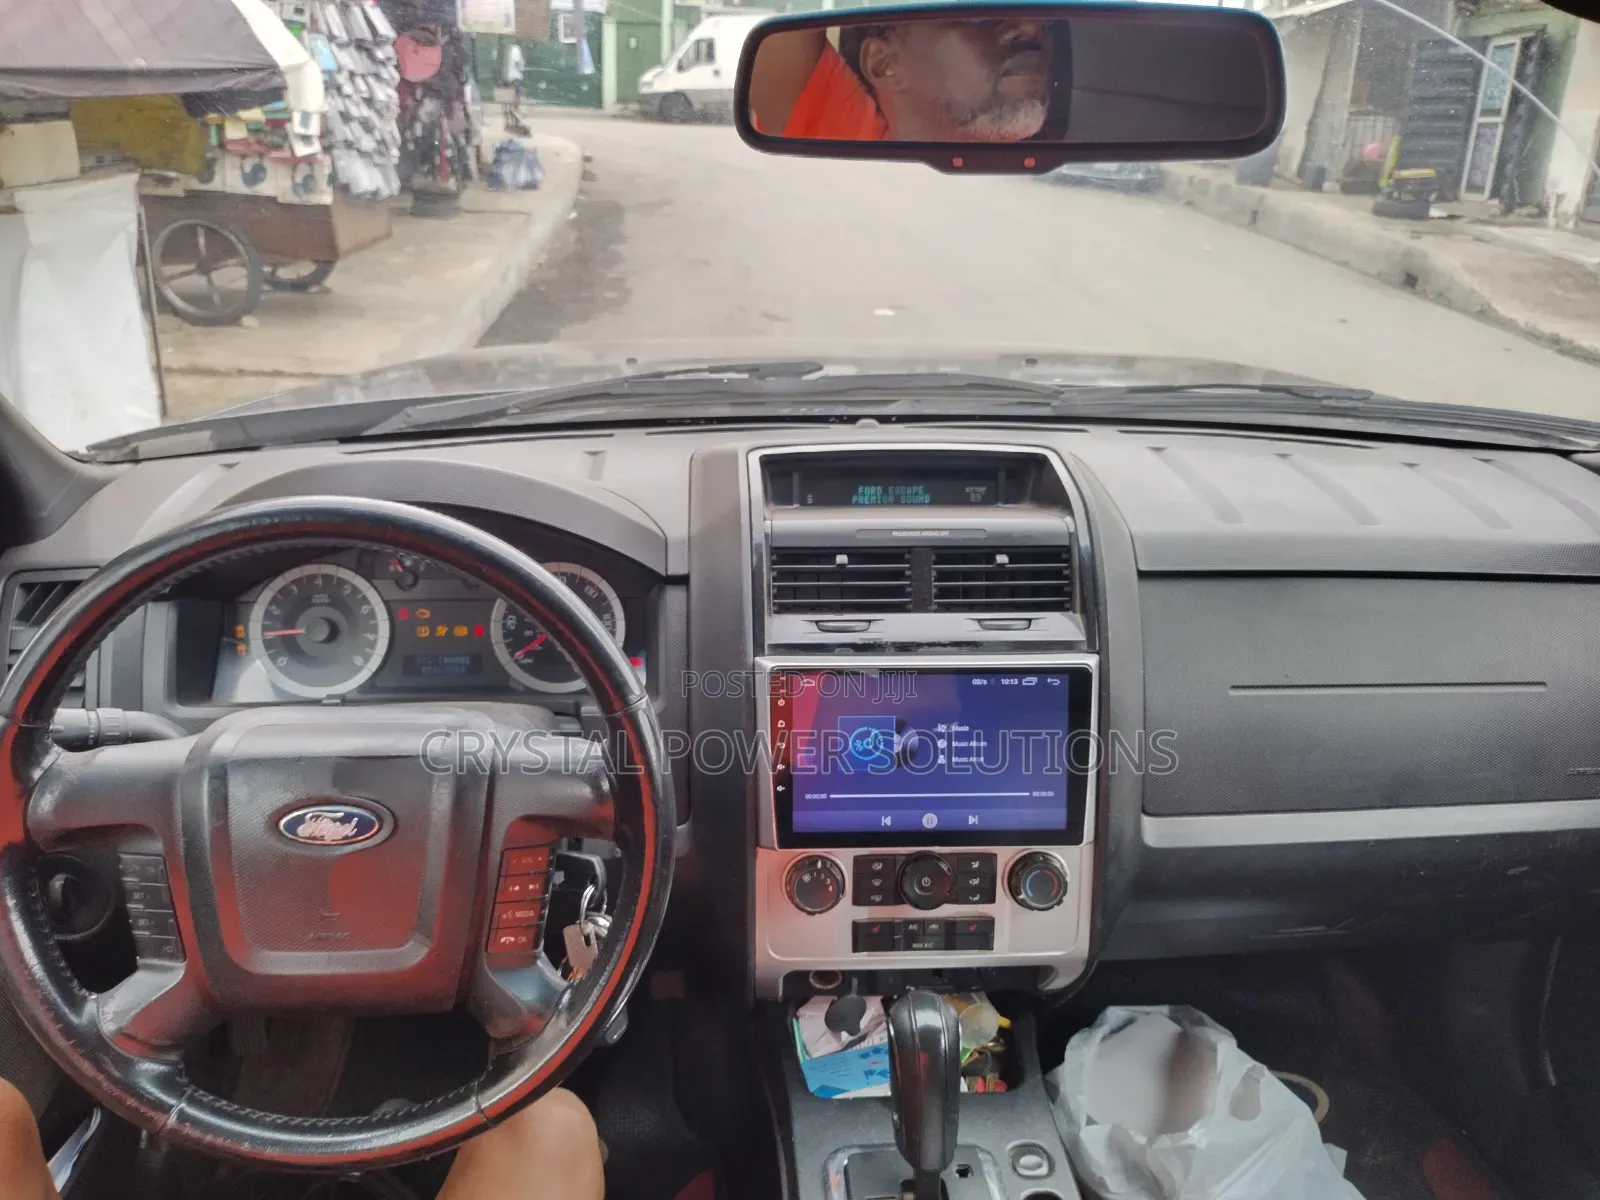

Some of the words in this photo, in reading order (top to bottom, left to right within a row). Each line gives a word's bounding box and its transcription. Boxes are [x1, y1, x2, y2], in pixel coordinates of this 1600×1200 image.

[858, 486, 883, 495] FORD
[887, 486, 925, 495] ESCAPE
[852, 495, 895, 504] PREMIUM
[900, 495, 931, 503] SOUND
[313, 577, 323, 588] 4
[270, 605, 281, 615] 2
[296, 812, 358, 841] Ford
[515, 910, 535, 918] MEDIA
